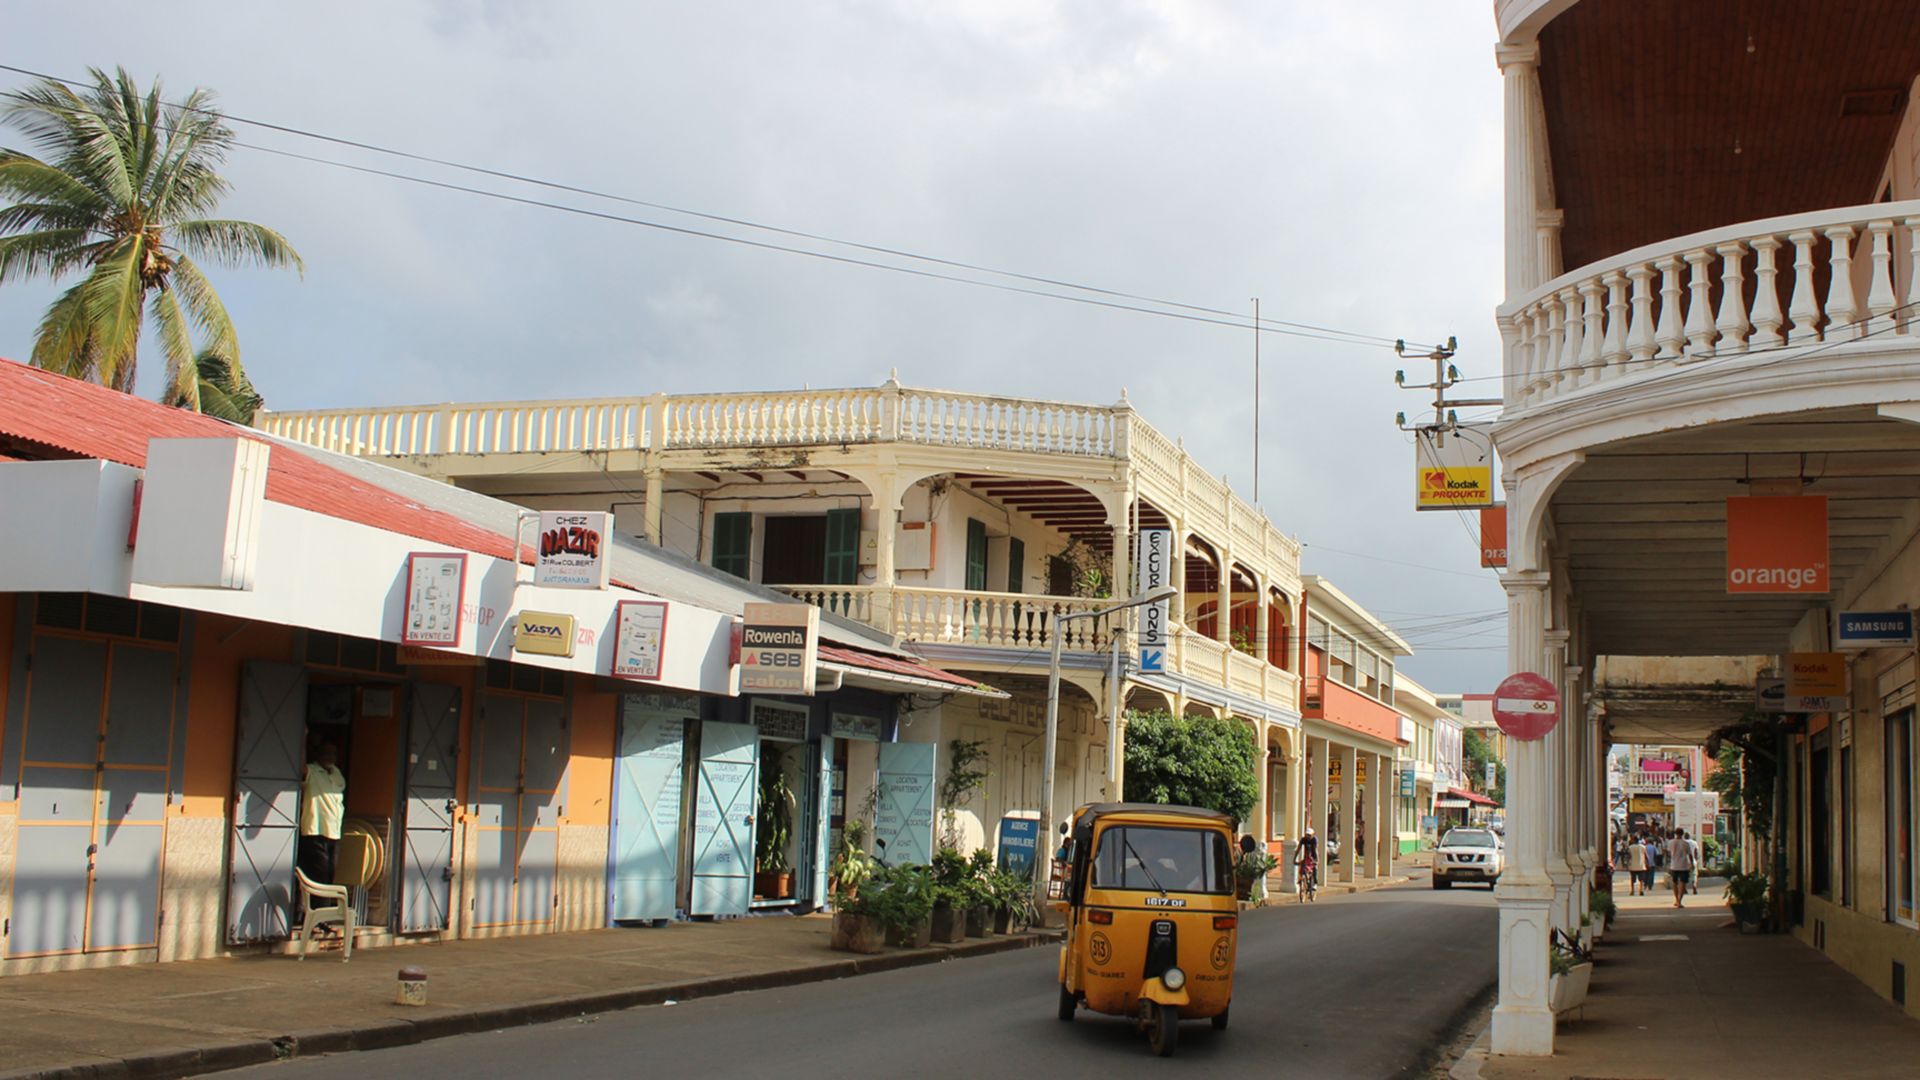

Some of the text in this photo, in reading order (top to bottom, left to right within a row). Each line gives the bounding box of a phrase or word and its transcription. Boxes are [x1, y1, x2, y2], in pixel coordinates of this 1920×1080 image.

[1447, 480, 1479, 489] Kodak
[1432, 490, 1486, 499] PRODUKTE
[556, 517, 588, 525] CHEZ
[541, 527, 600, 559] NAZIR
[1730, 567, 1817, 589] orange
[1148, 531, 1161, 643] EXCURONS
[463, 604, 496, 626] SHOP
[523, 623, 562, 636] VISTA
[1846, 621, 1905, 632] SAMSUNG
[410, 631, 419, 640] EN
[420, 631, 441, 640] VENTE
[744, 629, 804, 645] Rowenta
[1793, 664, 1829, 673] Kodak
[1171, 899, 1185, 907] DF
[1093, 939, 1106, 957] 313
